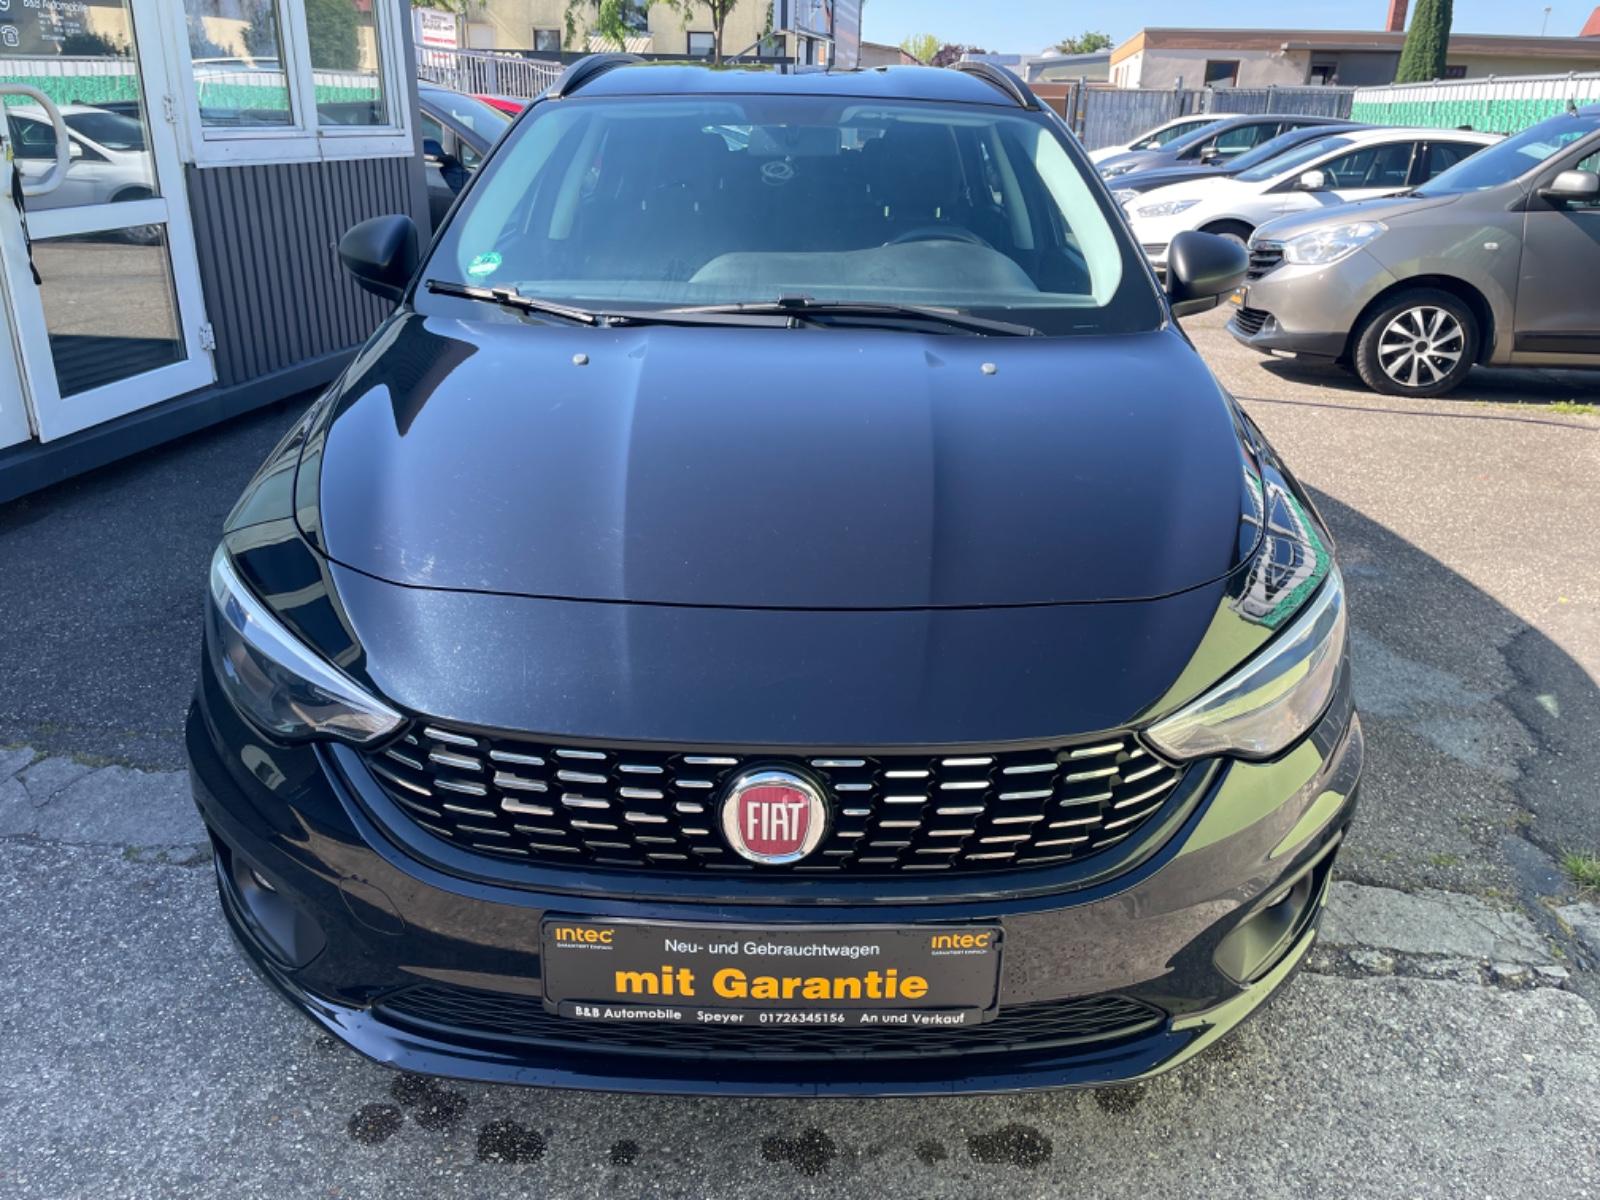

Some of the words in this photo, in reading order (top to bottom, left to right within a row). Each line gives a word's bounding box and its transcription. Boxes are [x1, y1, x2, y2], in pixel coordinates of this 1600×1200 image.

[747, 801, 804, 841] FIAT
[555, 927, 614, 943] intec
[931, 932, 991, 949] intec
[664, 938, 704, 954] Neu-
[709, 942, 739, 955] und
[744, 942, 880, 959] Gebrauchtwagen
[615, 965, 695, 996] mit
[712, 968, 929, 999] Garantie
[575, 1006, 600, 1018] B&B
[604, 1008, 682, 1020] Automobile
[697, 1011, 745, 1023] Speyer
[759, 1013, 846, 1024] 01726345156
[860, 1013, 879, 1023] An
[882, 1013, 908, 1024] und
[912, 1013, 965, 1024] Verkauf
